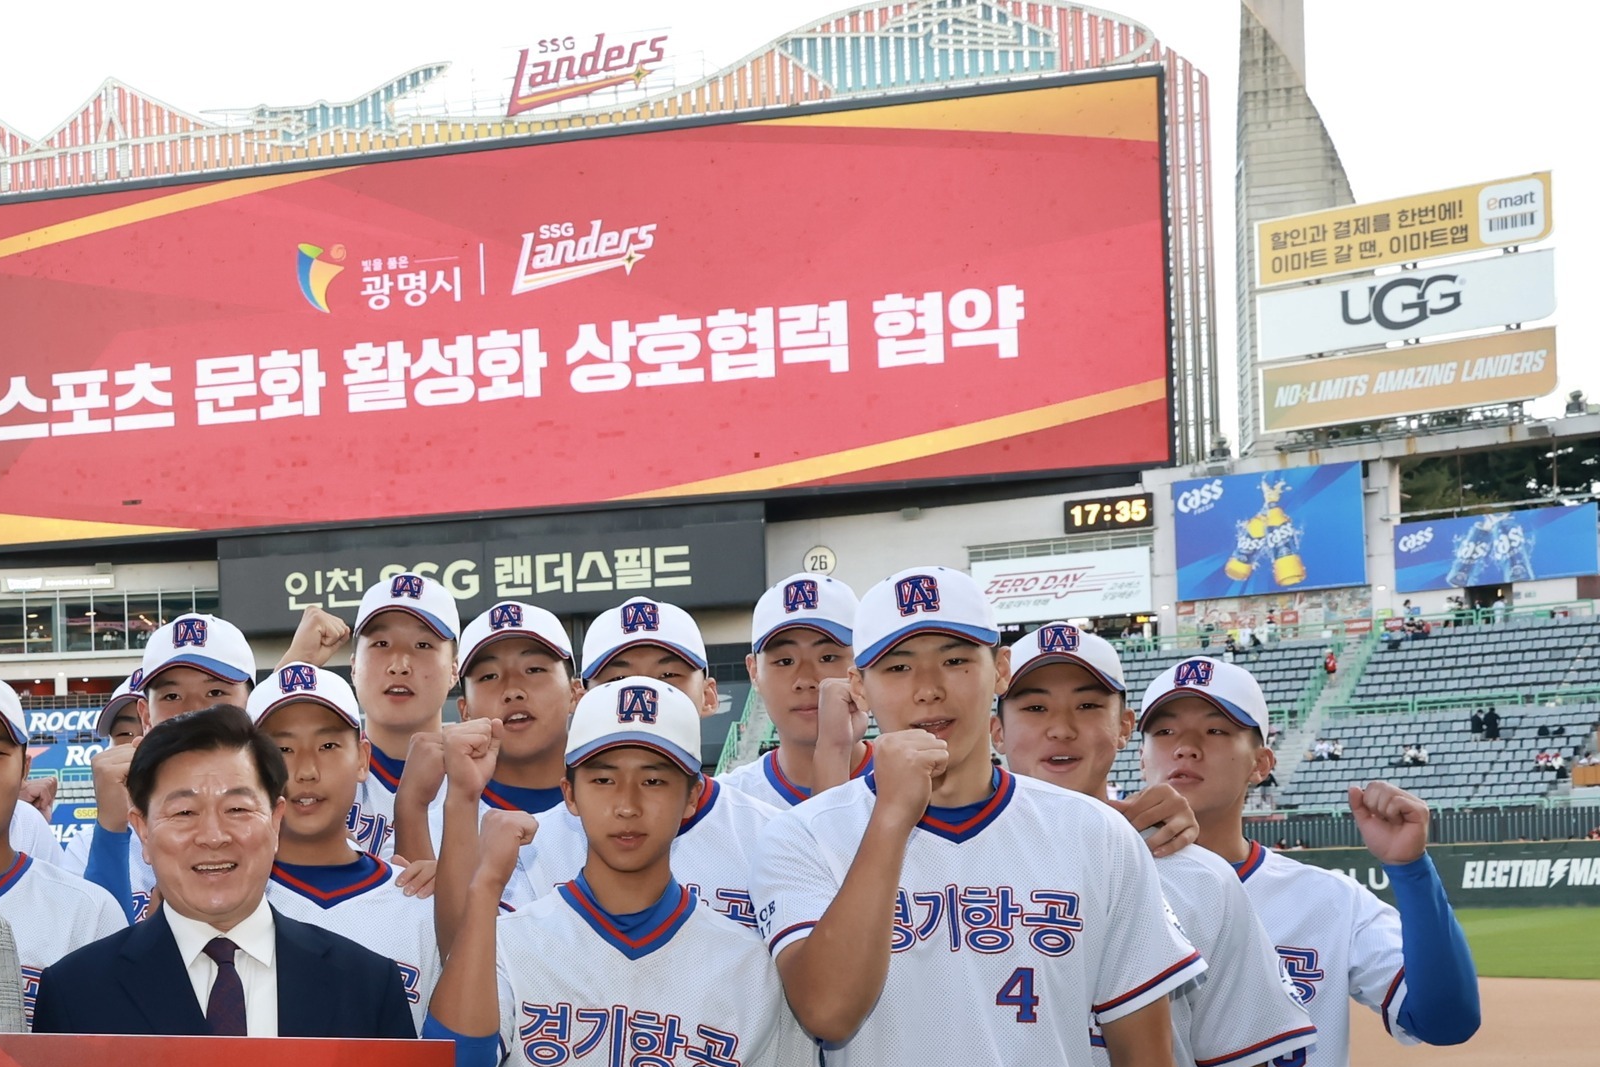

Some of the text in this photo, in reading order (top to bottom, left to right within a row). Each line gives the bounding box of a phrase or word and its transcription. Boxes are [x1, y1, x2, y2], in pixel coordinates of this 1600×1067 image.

[538, 36, 575, 53] SSG
[507, 33, 668, 117] Landers
[1487, 190, 1535, 210] emart
[539, 222, 574, 240] SSG
[1270, 200, 1463, 251] 할인과 결제를 한번에!
[361, 256, 409, 272] 빛을 품은
[511, 219, 657, 296] Landers
[1272, 248, 1328, 274] 이마트
[1334, 245, 1353, 264] 갈
[1389, 224, 1469, 253] 이마트앱
[360, 266, 461, 310] 광명시
[1340, 274, 1462, 330] UGG
[194, 348, 326, 425] 문화
[342, 327, 547, 413] 활성화
[566, 299, 849, 394] 상호협력
[872, 284, 1025, 368] 협약
[1372, 362, 1457, 395] AMAZING
[1461, 349, 1547, 382] LANDERS
[1070, 499, 1147, 526] 17:35
[1177, 479, 1224, 513] Cass
[286, 568, 364, 611] 인천
[494, 545, 692, 598] 랜더스필드
[810, 555, 828, 571] 26
[984, 572, 1086, 595] ZERO DAY
[996, 967, 1039, 1023] 4
